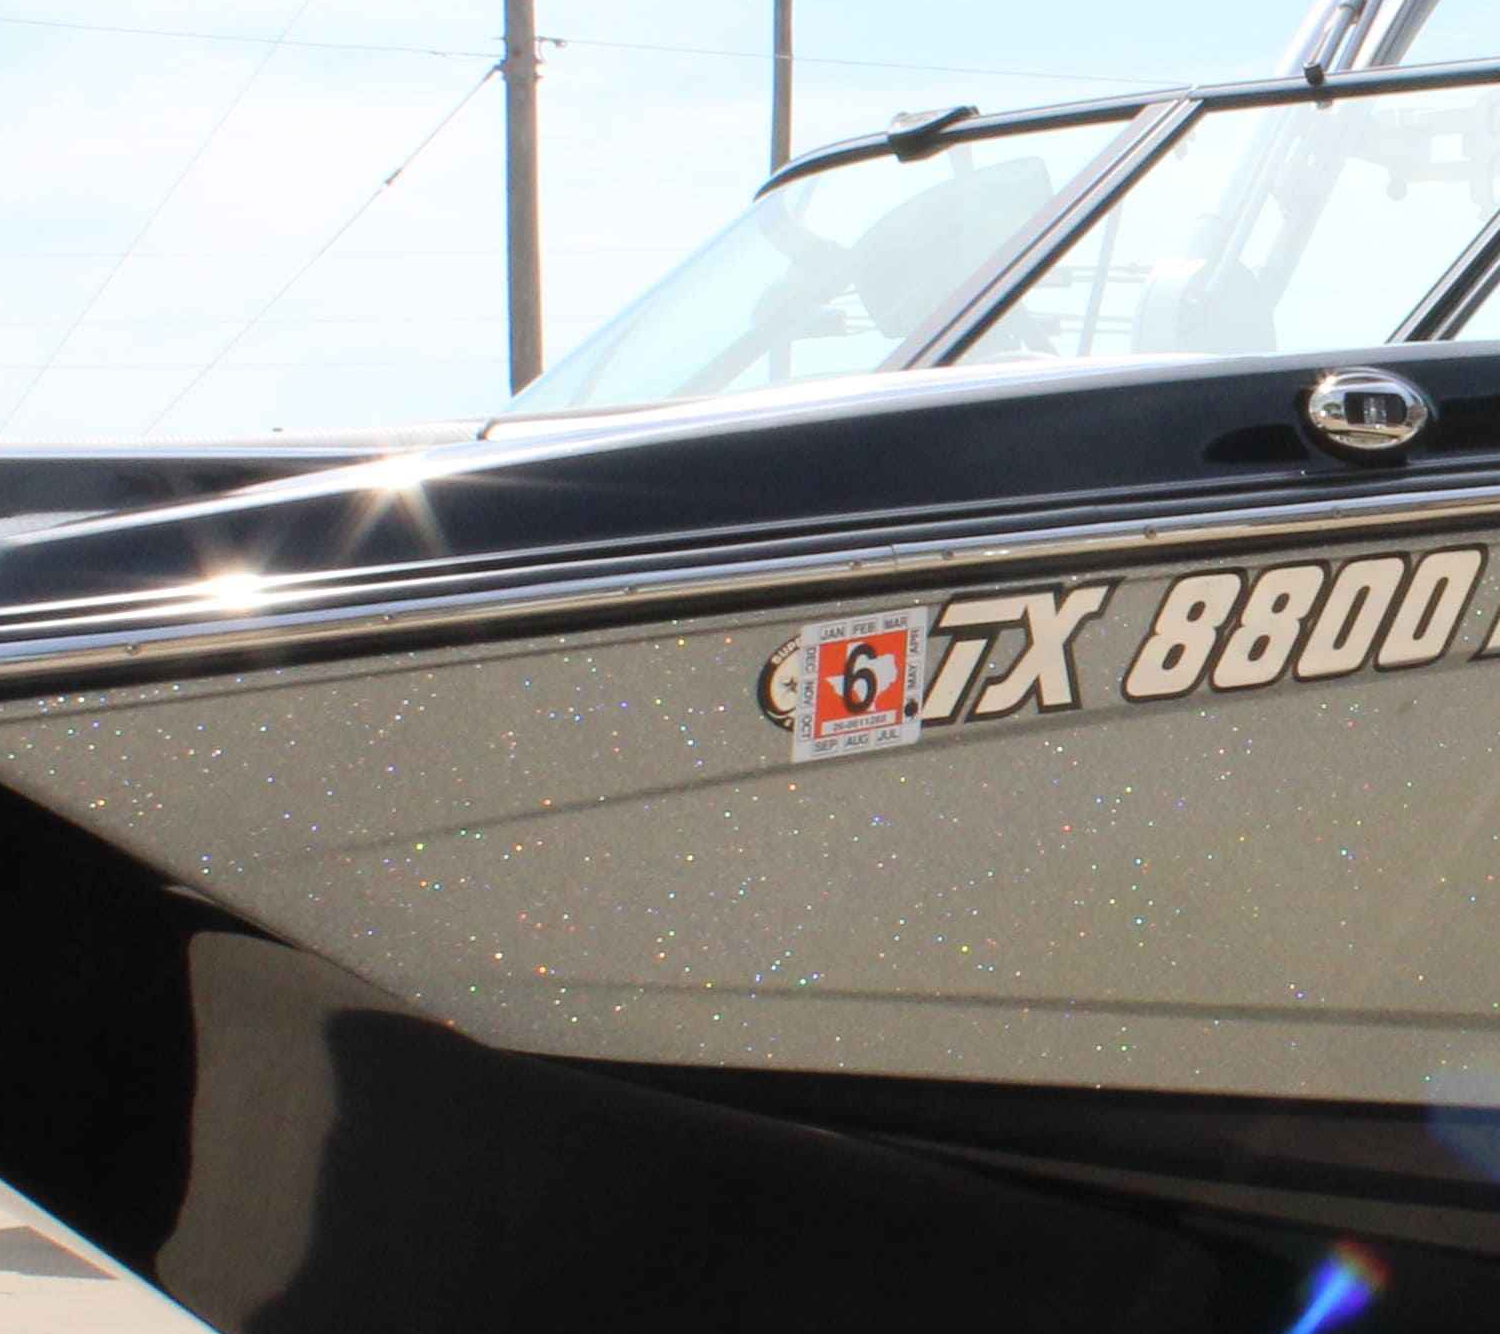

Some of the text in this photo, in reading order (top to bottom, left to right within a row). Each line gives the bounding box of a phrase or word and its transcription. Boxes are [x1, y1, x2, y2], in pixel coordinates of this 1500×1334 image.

[821, 615, 908, 641] JAN FEB MAR
[918, 576, 1123, 728] TX
[1122, 543, 1489, 704] 8800
[844, 642, 878, 715] 6
[813, 728, 900, 753] SEP AUG JUL
